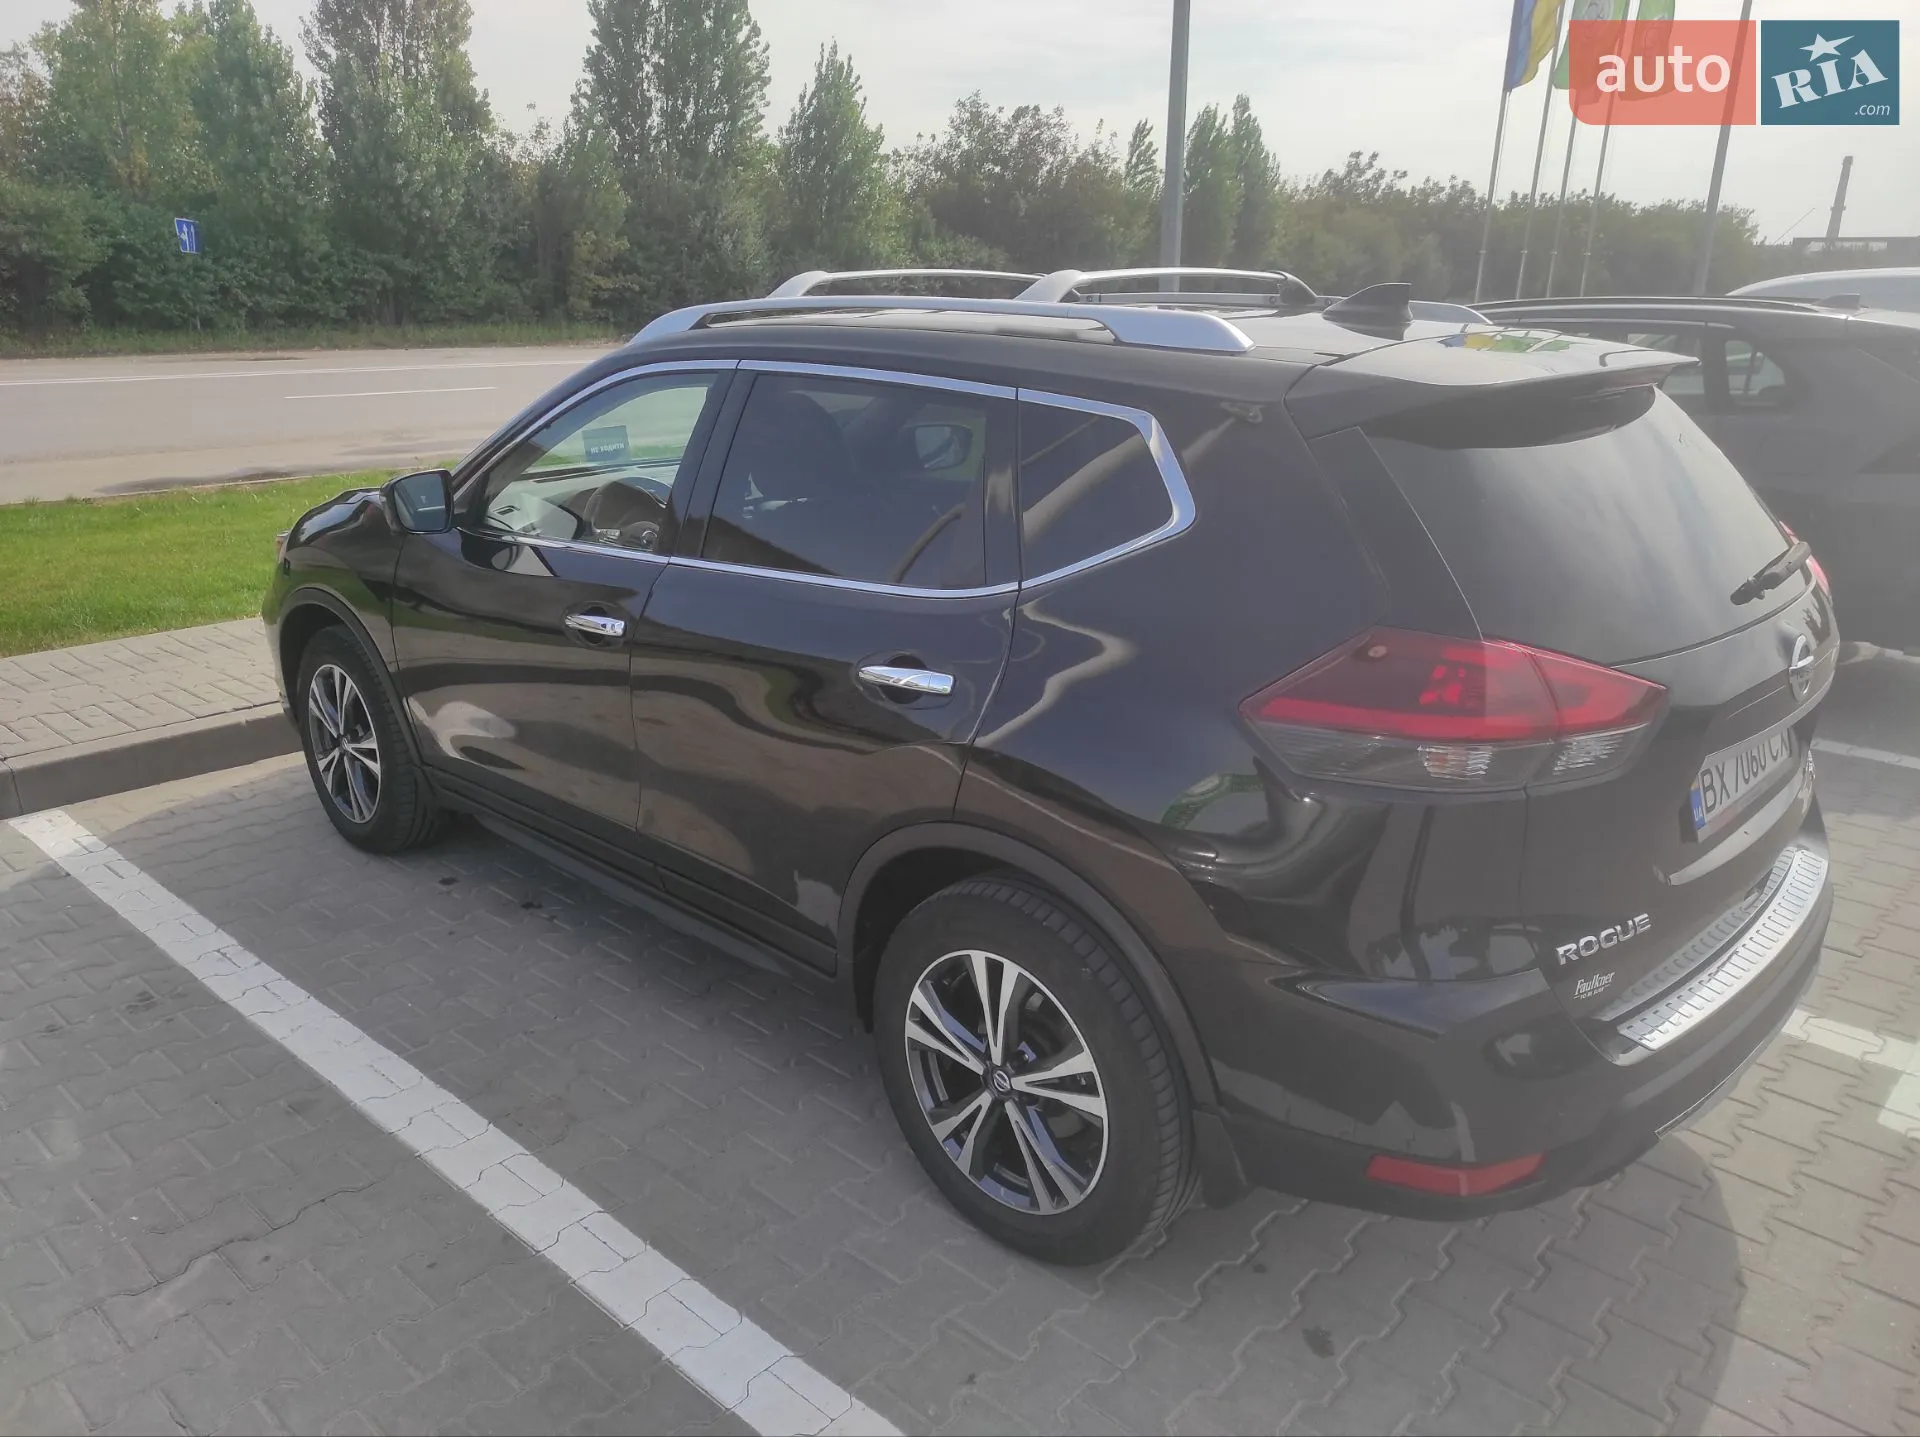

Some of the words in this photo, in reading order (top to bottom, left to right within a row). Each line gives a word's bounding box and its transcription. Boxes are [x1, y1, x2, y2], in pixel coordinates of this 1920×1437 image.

[1700, 761, 1731, 813] BX
[1555, 913, 1652, 966] ROGUE
[1574, 971, 1616, 996] Faulkner
